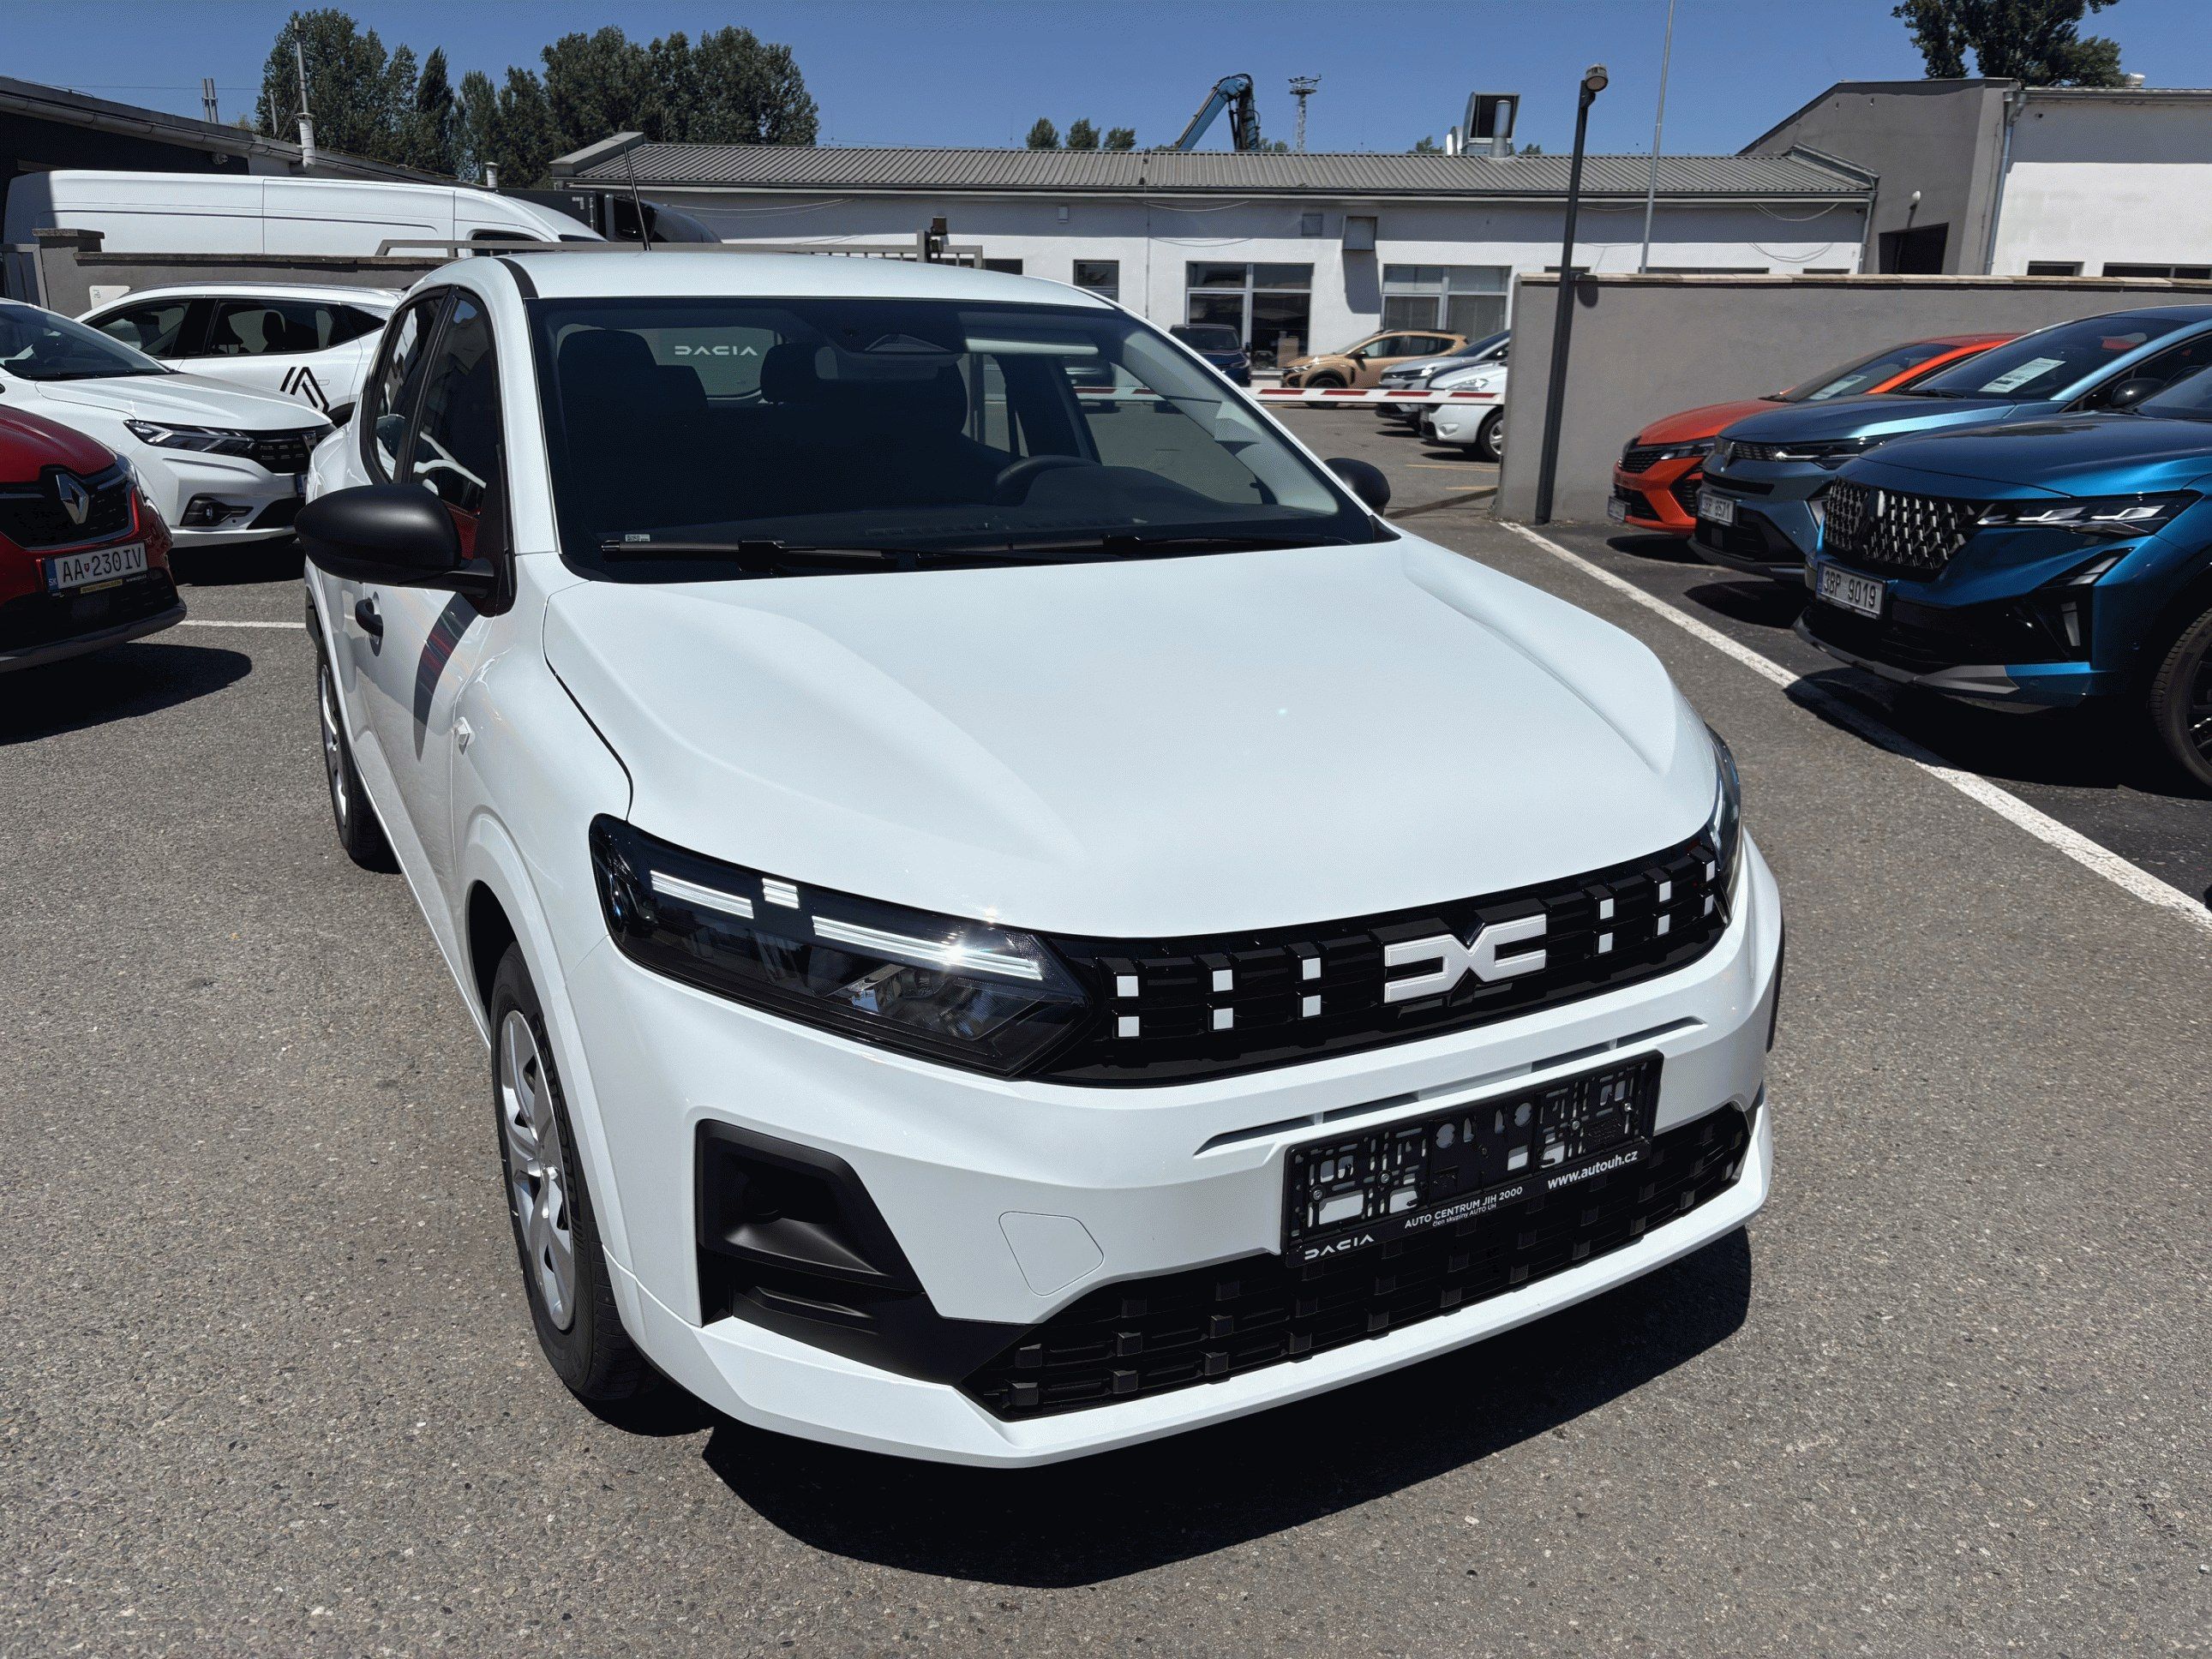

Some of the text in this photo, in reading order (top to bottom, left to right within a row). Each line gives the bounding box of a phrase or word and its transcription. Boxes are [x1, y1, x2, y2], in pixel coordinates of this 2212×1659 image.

[674, 345, 758, 356] DACIA
[1824, 570, 1876, 608] 3BP 9019
[1547, 1151, 1638, 1189] www.autouh.cz
[1405, 1186, 1523, 1229] AUTO CENTRUM JIH 2000
[1447, 1210, 1468, 1223] skupiny
[1469, 1206, 1487, 1216] AUTO
[1488, 1202, 1496, 1211] UH
[1304, 1234, 1375, 1261] DACIA
